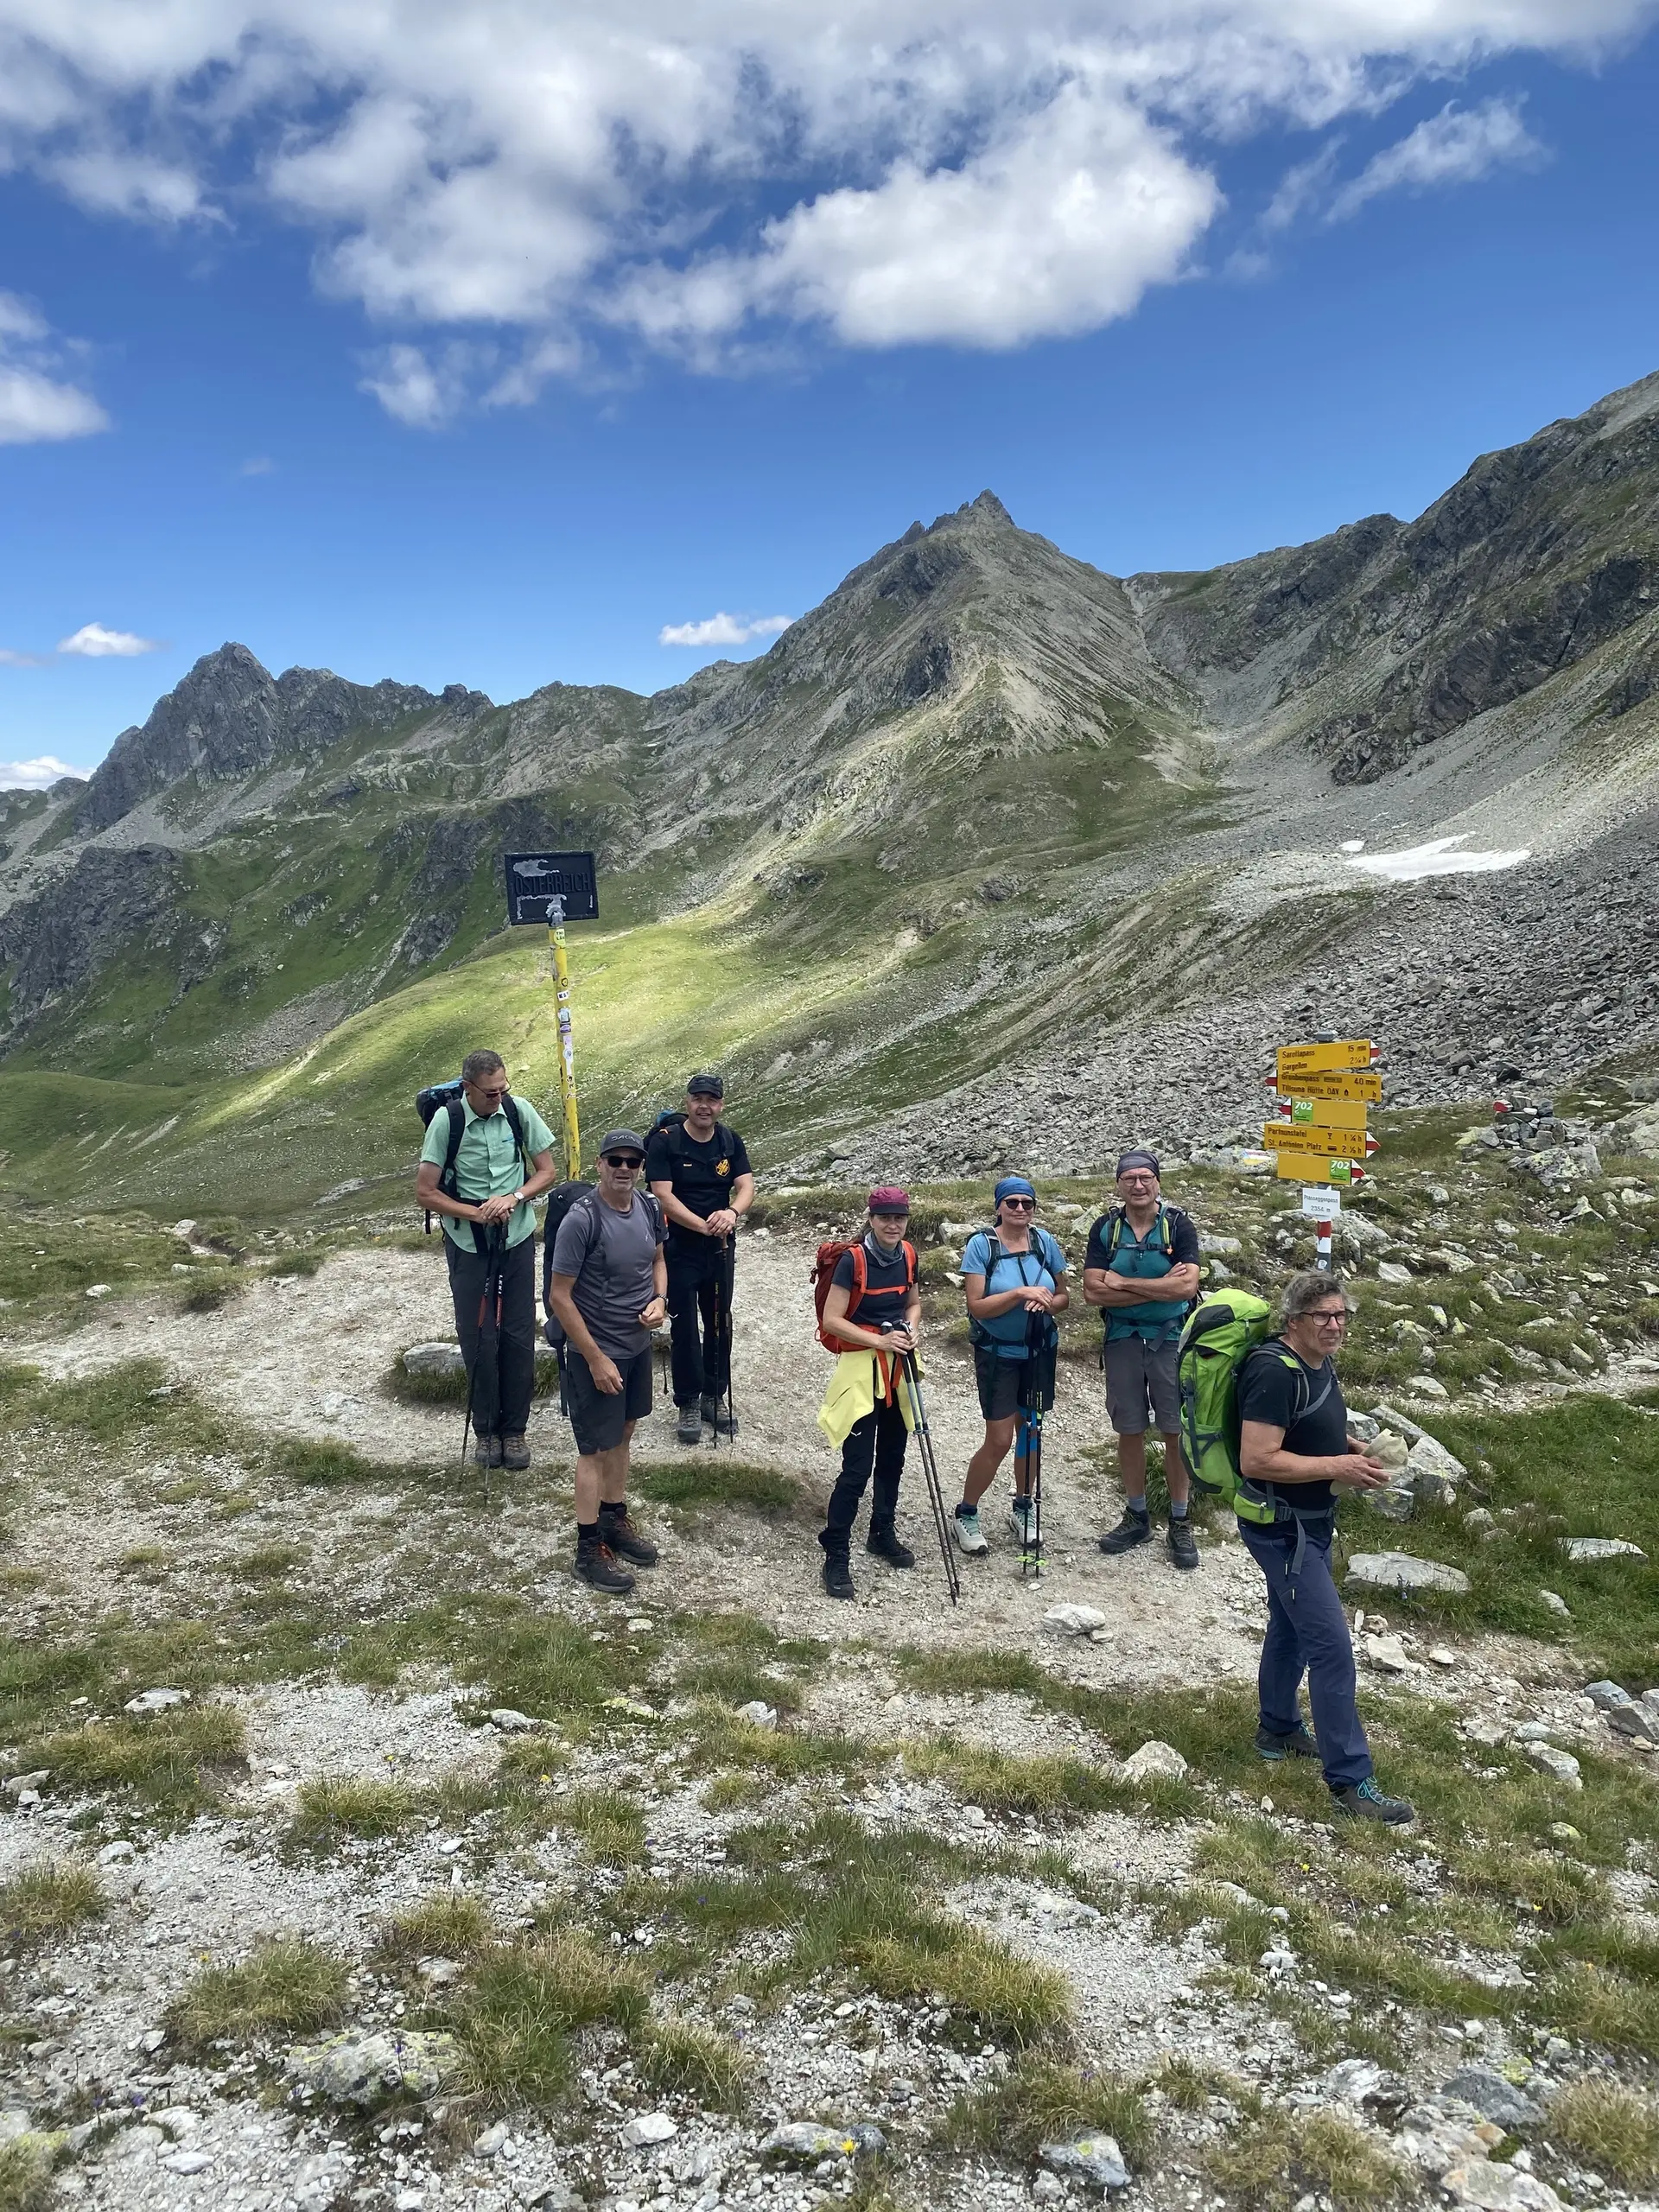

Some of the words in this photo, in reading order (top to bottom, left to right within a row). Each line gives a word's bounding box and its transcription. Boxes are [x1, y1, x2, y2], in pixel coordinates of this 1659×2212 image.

[1281, 1062, 1308, 1071] Gargellen
[1294, 1101, 1313, 1110] 702
[1268, 1127, 1307, 1137] Partnunstafel
[1268, 1138, 1277, 1147] St.
[1279, 1140, 1304, 1148] Antönien
[1306, 1141, 1322, 1150] Platz
[1331, 1160, 1350, 1170] 702
